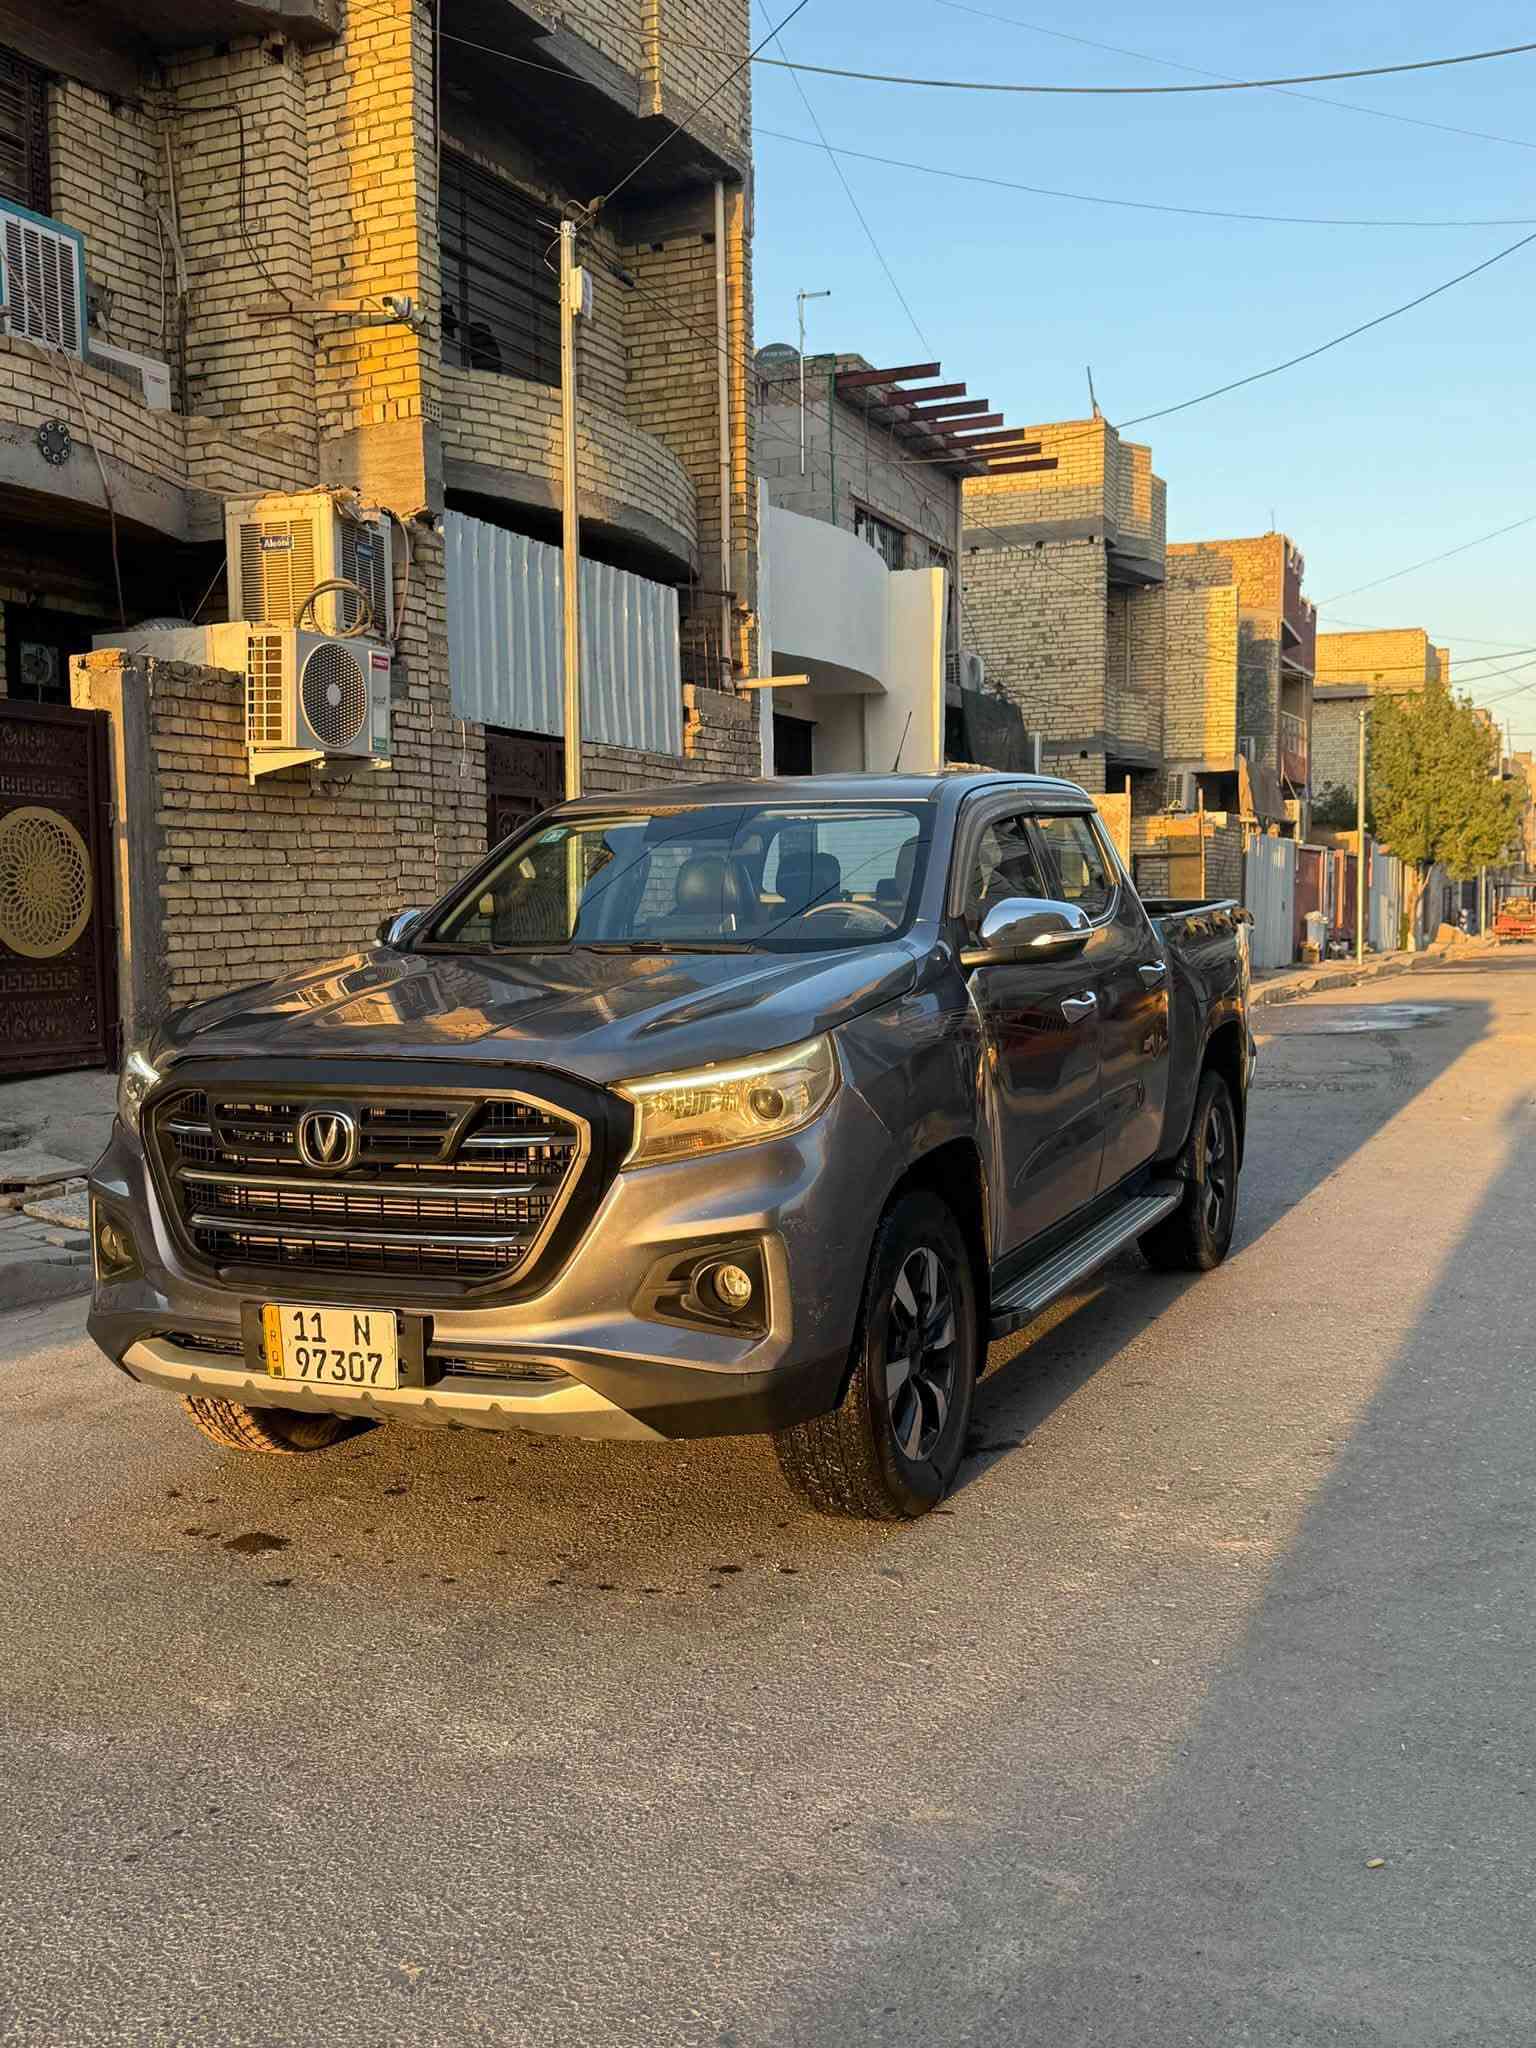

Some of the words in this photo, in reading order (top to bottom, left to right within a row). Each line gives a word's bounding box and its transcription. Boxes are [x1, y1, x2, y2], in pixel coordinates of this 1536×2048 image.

[293, 1311, 327, 1343] 11
[353, 1314, 371, 1346] N
[295, 1347, 383, 1384] 97307
